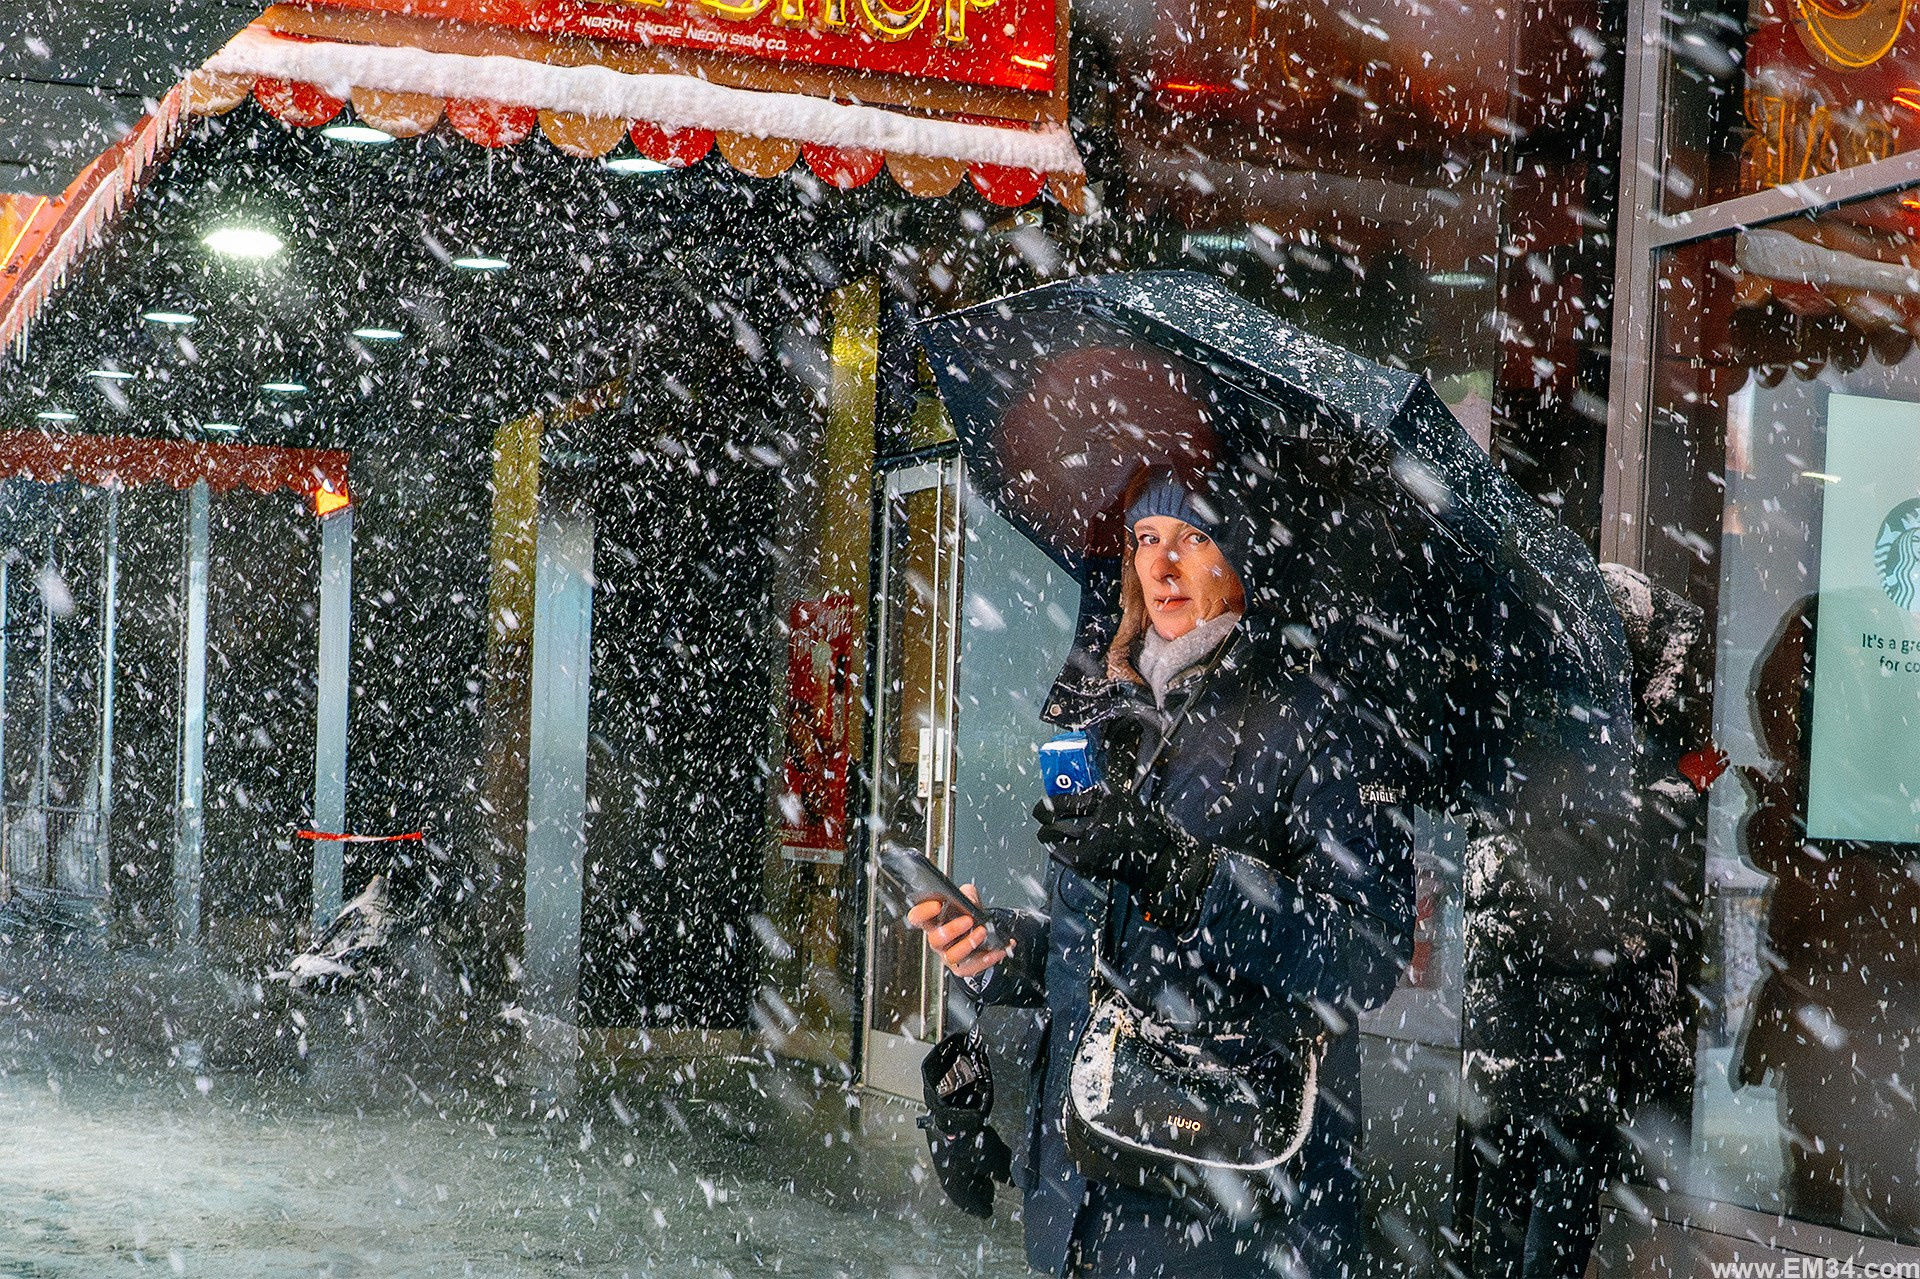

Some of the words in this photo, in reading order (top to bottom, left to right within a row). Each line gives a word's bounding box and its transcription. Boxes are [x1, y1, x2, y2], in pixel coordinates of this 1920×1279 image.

[580, 15, 629, 32] NORTH
[634, 21, 682, 38] SHORE
[686, 28, 728, 43] NEON
[730, 33, 763, 48] SIGN
[1862, 633, 1884, 649] It's
[1889, 639, 1896, 650] a
[1880, 655, 1900, 671] for
